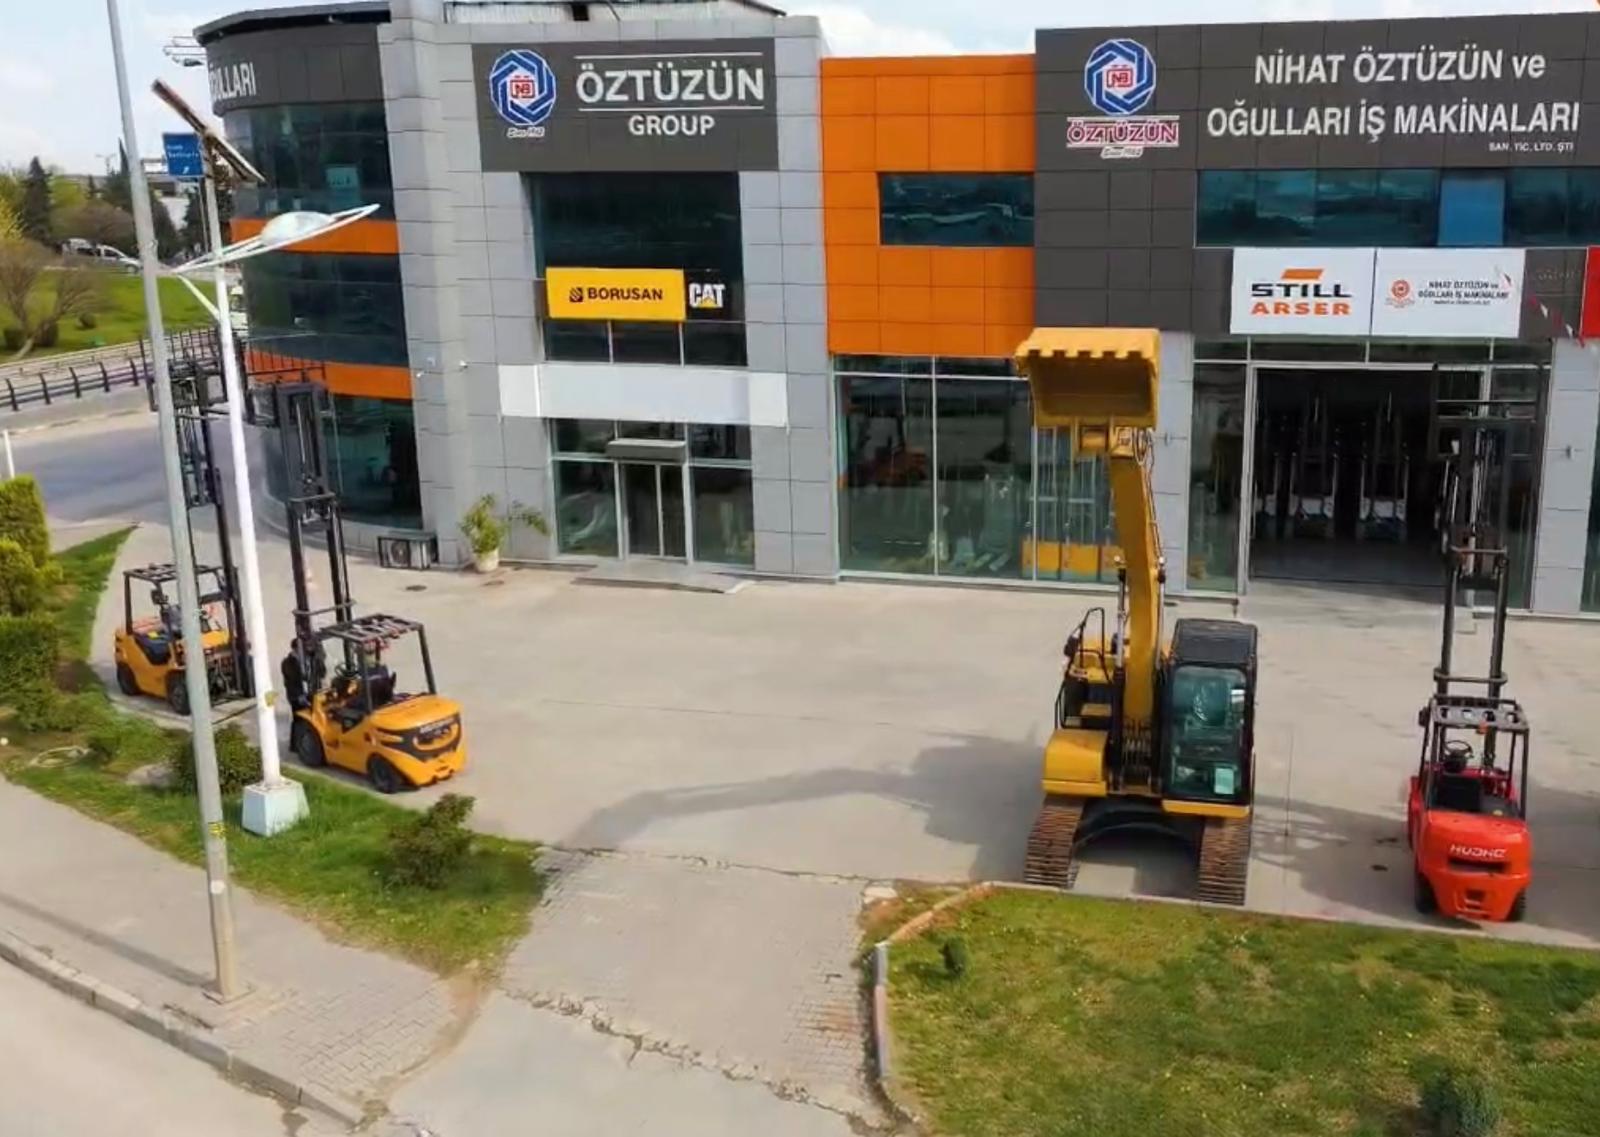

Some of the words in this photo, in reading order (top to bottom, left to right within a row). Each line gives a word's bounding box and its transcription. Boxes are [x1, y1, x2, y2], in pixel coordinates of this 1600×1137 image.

[1254, 48, 1346, 84] NİHAT
[1353, 44, 1503, 83] ÖZTÜZÜN
[1511, 54, 1546, 79] ve
[575, 61, 764, 103] ÖZTÜZÜN
[628, 115, 715, 135] GROUP
[1067, 120, 1179, 144] ÖZTÜZÜN
[1207, 99, 1351, 137] OĞULLARI
[1358, 99, 1386, 143] İŞ
[1393, 97, 1580, 135] MAKİNALARI
[587, 287, 663, 301] BORUSAN
[688, 283, 726, 308] CAT
[1251, 283, 1353, 298] STILL
[1251, 302, 1351, 315] ARSER
